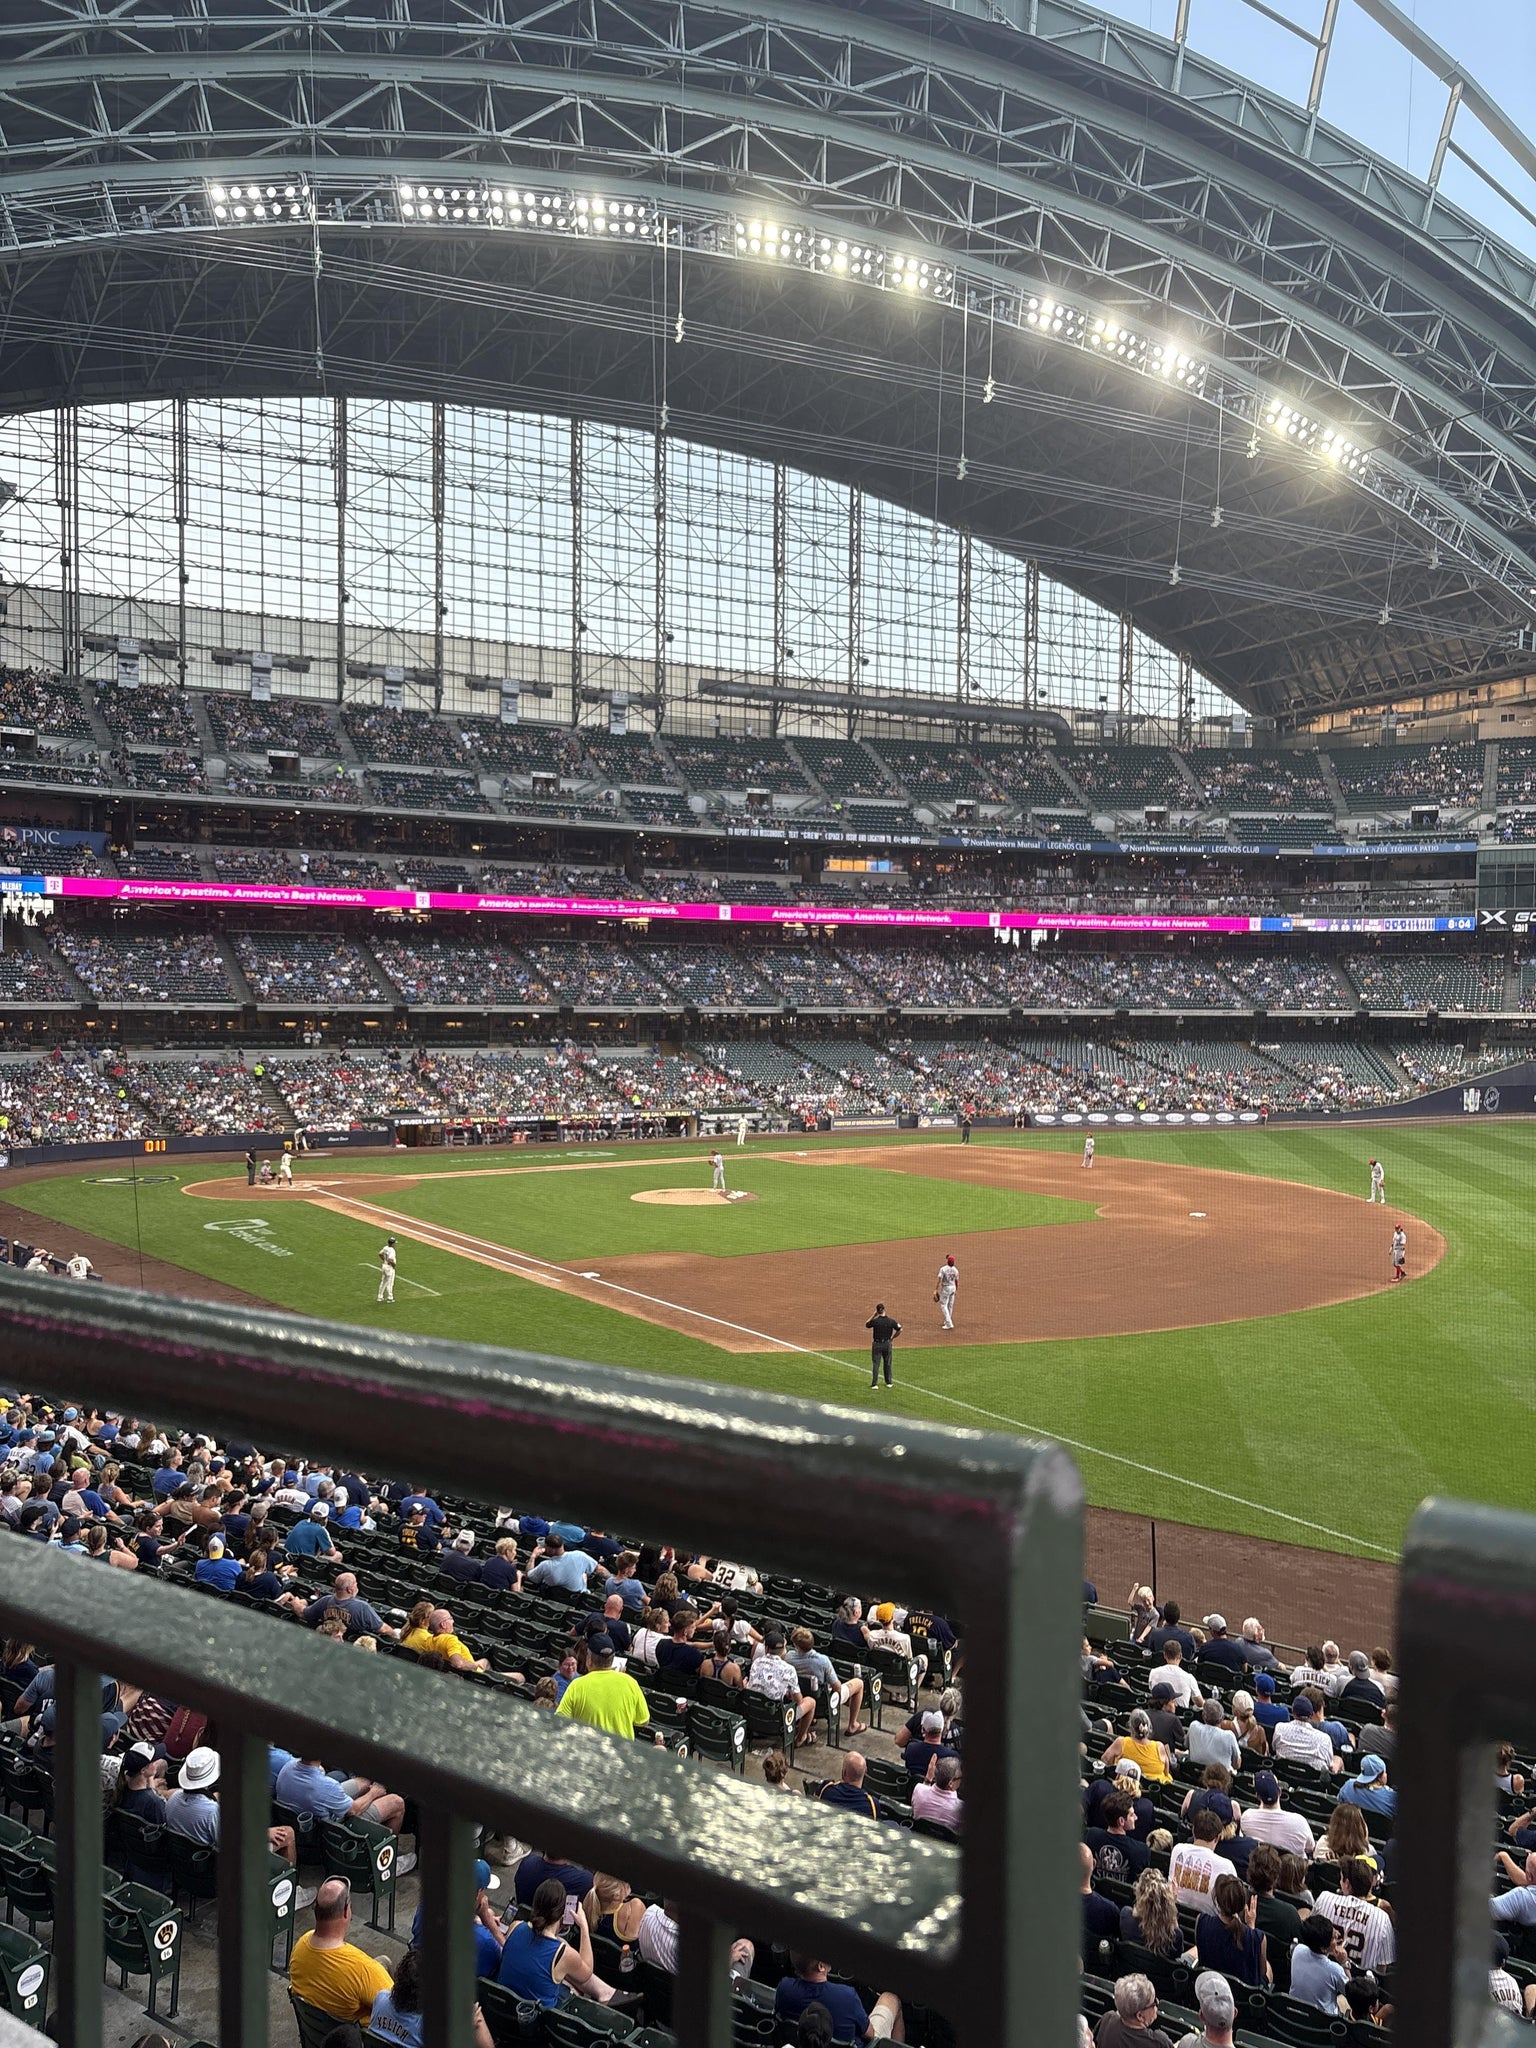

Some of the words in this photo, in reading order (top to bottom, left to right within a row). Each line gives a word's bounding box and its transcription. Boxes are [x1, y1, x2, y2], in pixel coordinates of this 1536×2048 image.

[21, 828, 60, 845] PNC
[788, 830, 798, 838] TEXT
[970, 839, 1016, 848] Northwestern
[1017, 840, 1040, 849] Mutual
[1047, 841, 1074, 850] LEGENDS
[1075, 842, 1091, 851] CLUB
[1129, 844, 1178, 853] Northwestern
[1179, 845, 1204, 853] Mutual
[1211, 845, 1241, 853] LEGENDS
[1391, 845, 1418, 853] TEQUILA
[121, 884, 181, 895] America's
[182, 886, 232, 898] pastime.
[233, 888, 290, 899] America's
[291, 890, 315, 901] Best
[317, 891, 367, 903] Network.
[478, 898, 528, 908] America's
[639, 905, 679, 915] Network.
[772, 910, 816, 919] America's
[816, 911, 853, 922] pastime.
[854, 912, 895, 922] America's
[896, 914, 914, 922] Best
[915, 914, 952, 923] Network.
[1037, 917, 1076, 926] America's
[1076, 918, 1110, 928] pastime.
[1110, 918, 1150, 927] America's
[1151, 919, 1170, 928] Best
[1171, 919, 1210, 928] Network.
[1447, 919, 1471, 929] 8:04
[74, 1263, 81, 1272] 9
[715, 1566, 735, 1587] 32
[909, 1615, 933, 1629] FRELICK
[1334, 1903, 1370, 1926] YELICH
[377, 2016, 409, 2042] YELICH
